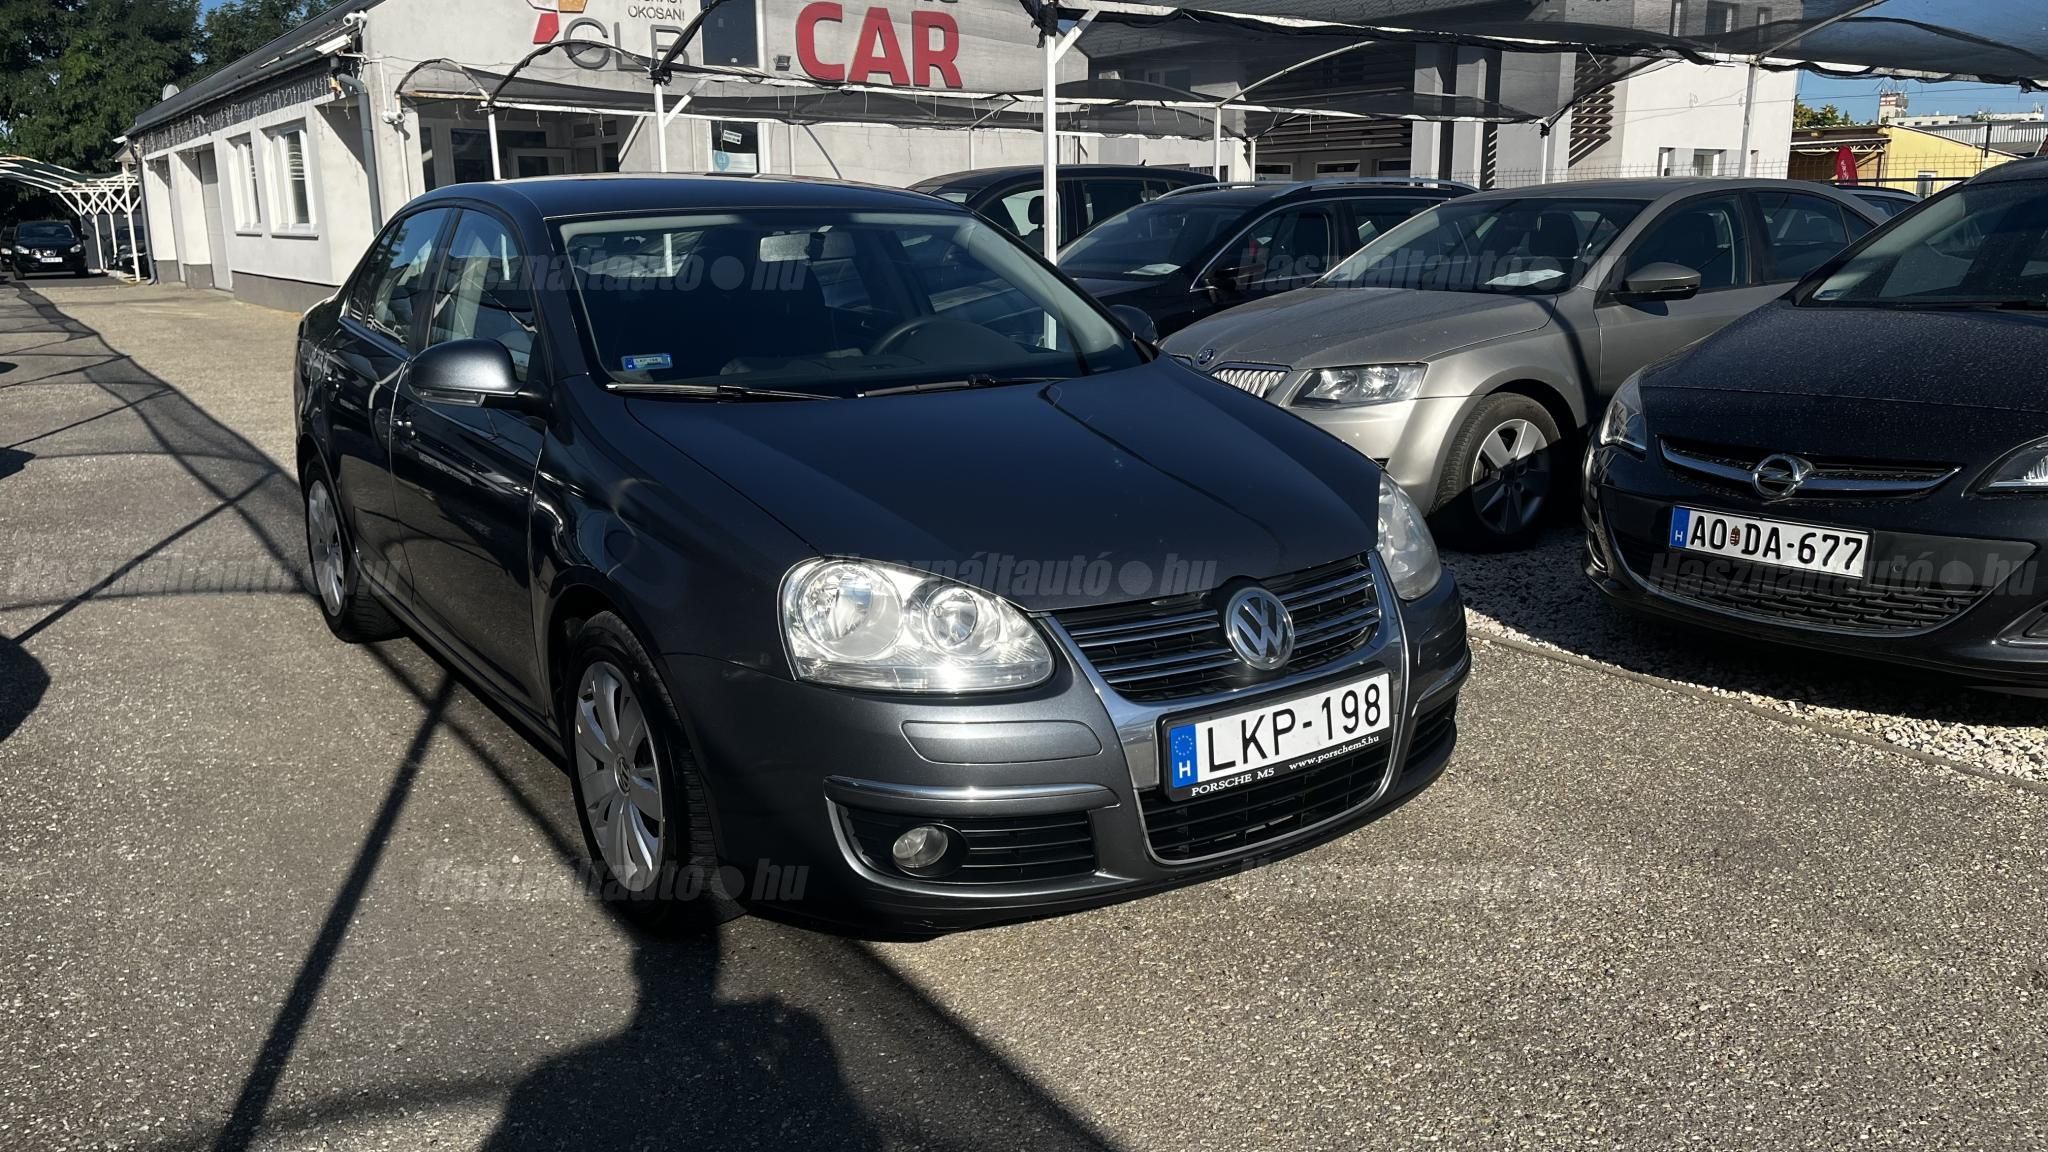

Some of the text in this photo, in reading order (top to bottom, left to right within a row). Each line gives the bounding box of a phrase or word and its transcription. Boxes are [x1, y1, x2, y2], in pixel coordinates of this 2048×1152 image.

[795, 1, 963, 89] CAR
[1675, 516, 1864, 571] H AO DA-677
[1178, 683, 1381, 779] H LKP-198
[1191, 735, 1380, 797] PORSCHE M5 www.porschem5.hu
